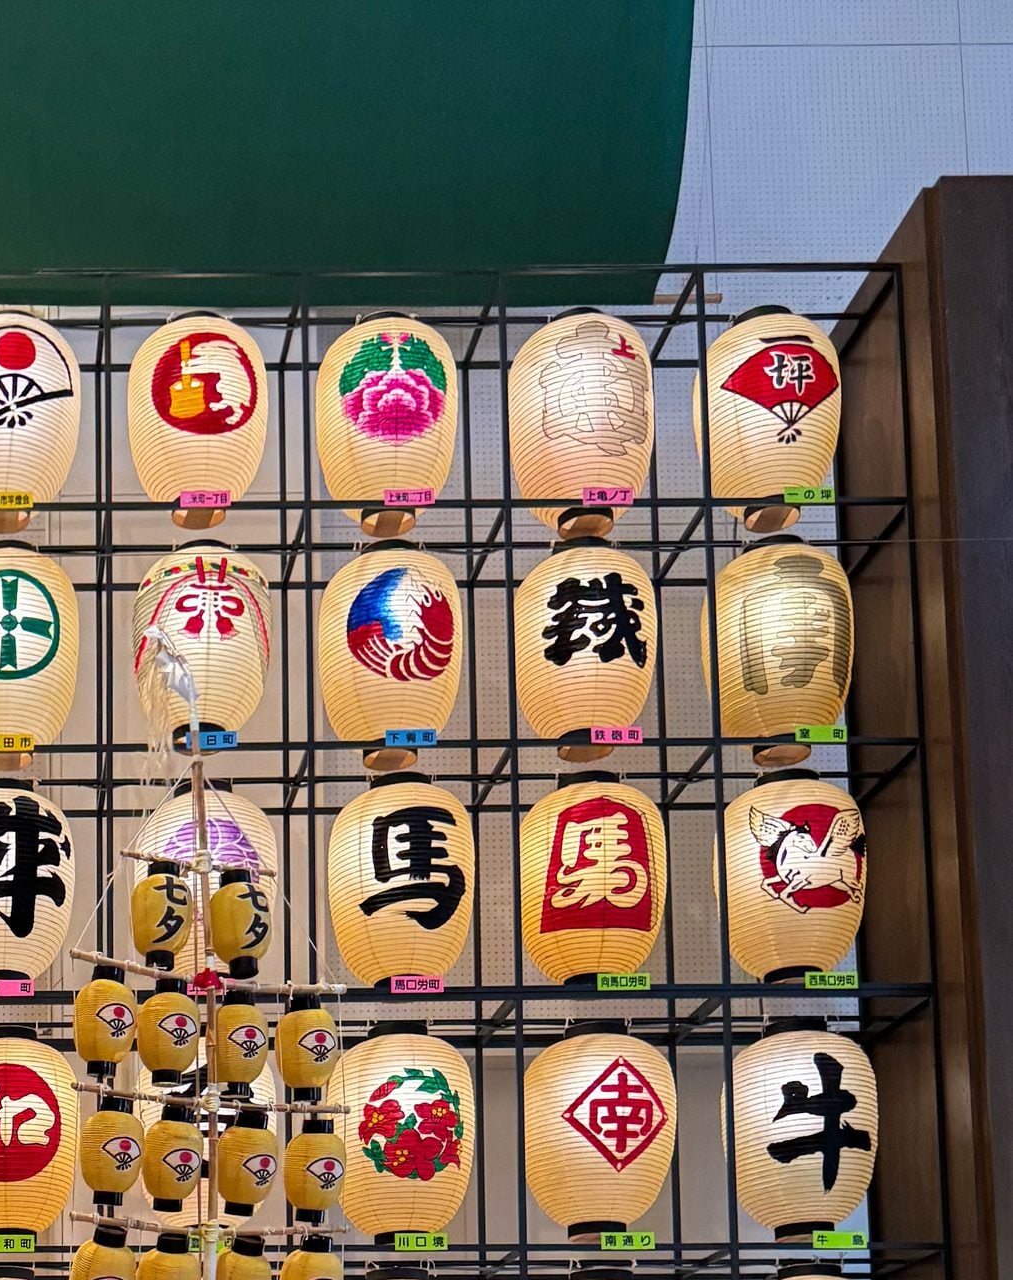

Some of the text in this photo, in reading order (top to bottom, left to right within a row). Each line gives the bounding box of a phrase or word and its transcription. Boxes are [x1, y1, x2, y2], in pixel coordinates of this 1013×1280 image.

[611, 334, 637, 360] 上
[787, 489, 832, 500] 一の坪
[594, 730, 639, 741] 鉄砲町
[799, 728, 843, 738] 室町
[360, 806, 467, 929] 馬
[550, 812, 648, 909] 馬
[152, 876, 187, 943] 七夕
[237, 884, 269, 949] 七夕
[767, 1053, 871, 1192] 牛
[398, 1236, 444, 1247] 川口境
[605, 1235, 651, 1246] 南通り
[817, 1235, 864, 1245] 牛島
